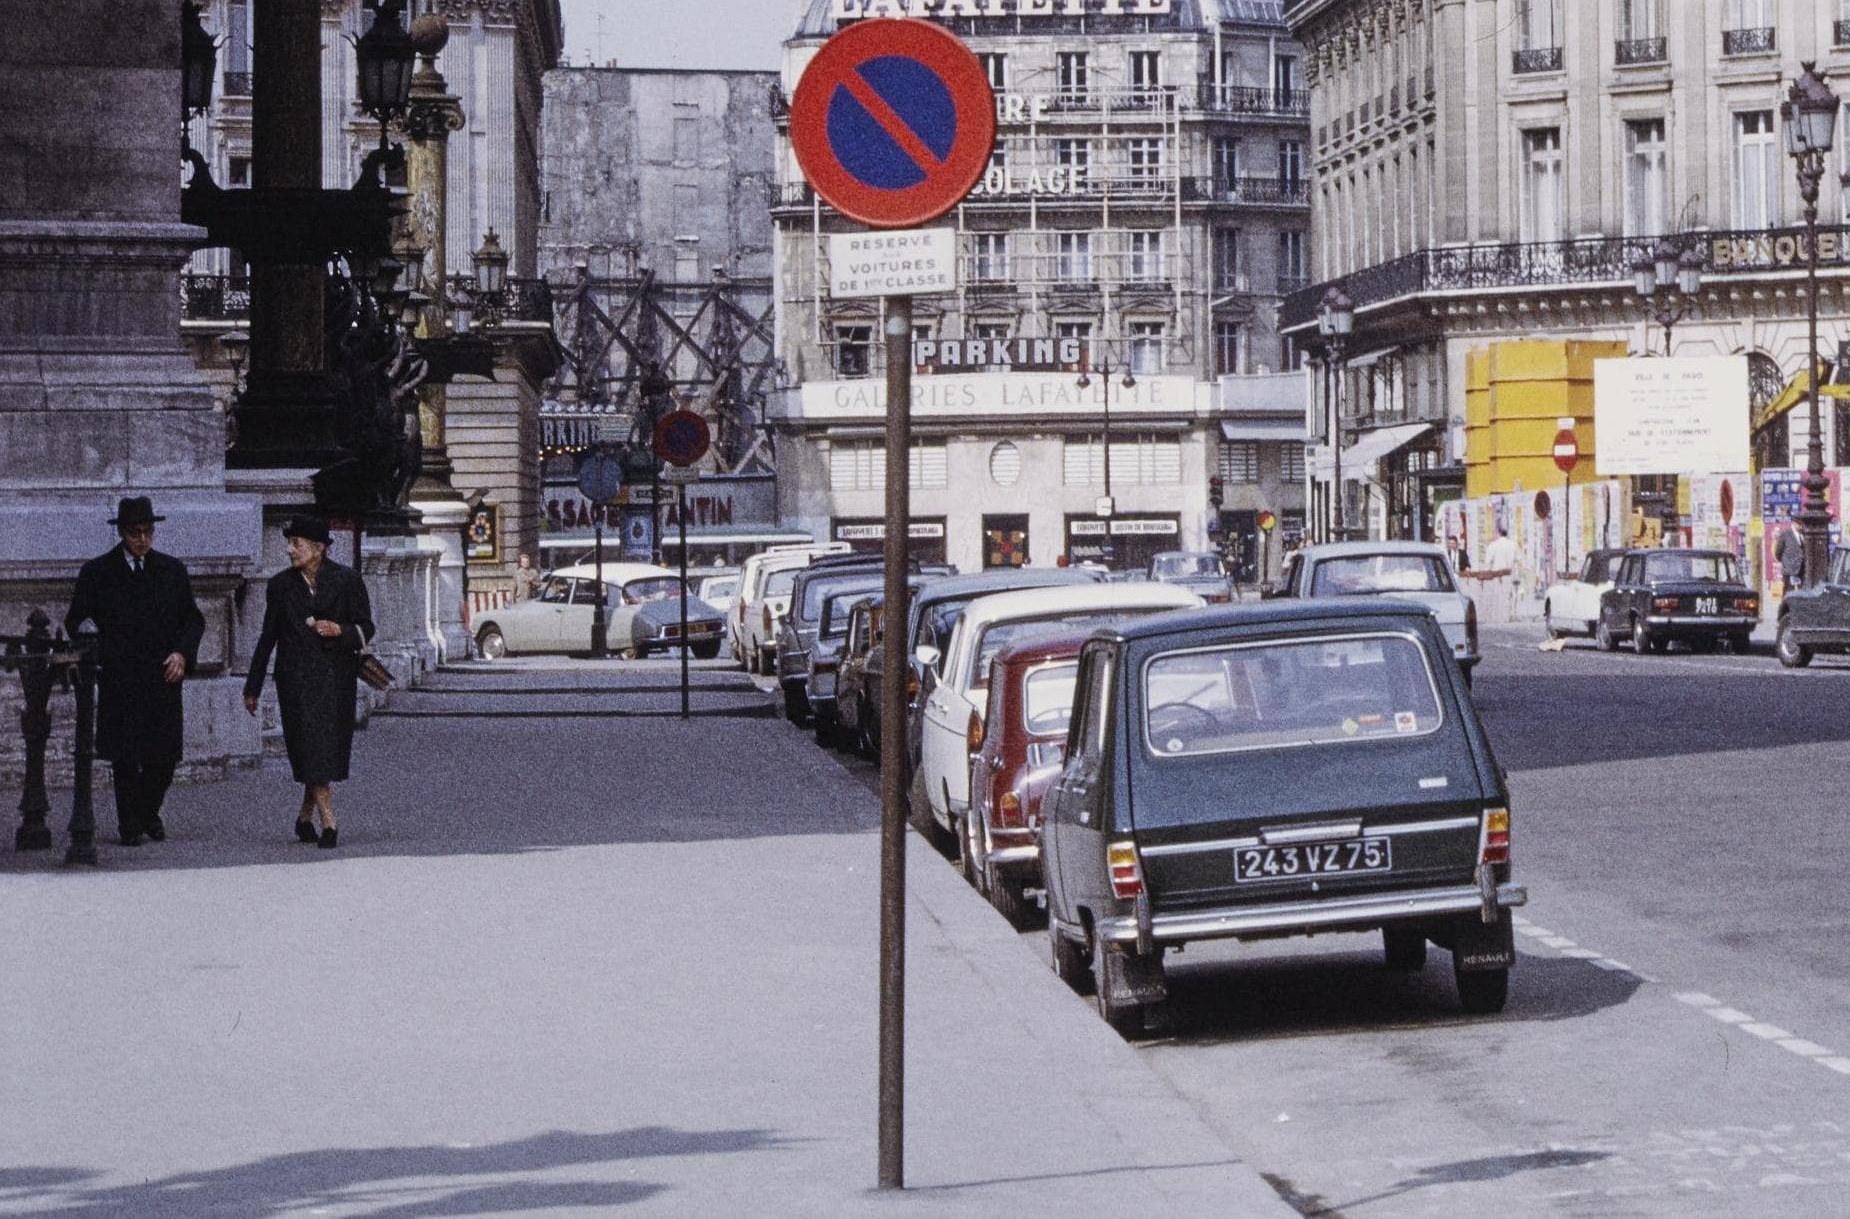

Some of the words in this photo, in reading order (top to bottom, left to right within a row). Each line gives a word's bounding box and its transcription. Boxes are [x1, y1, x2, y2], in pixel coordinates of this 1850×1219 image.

[1712, 231, 1837, 266] BANQUE
[848, 259, 937, 274] VOITURES
[839, 280, 859, 291] DE
[885, 274, 946, 288] CLASSE
[916, 338, 1080, 366] PARKING
[834, 385, 977, 408] GALRIES
[1245, 847, 1299, 877] 243
[1305, 844, 1341, 872] VZ
[1346, 841, 1381, 868] 75
